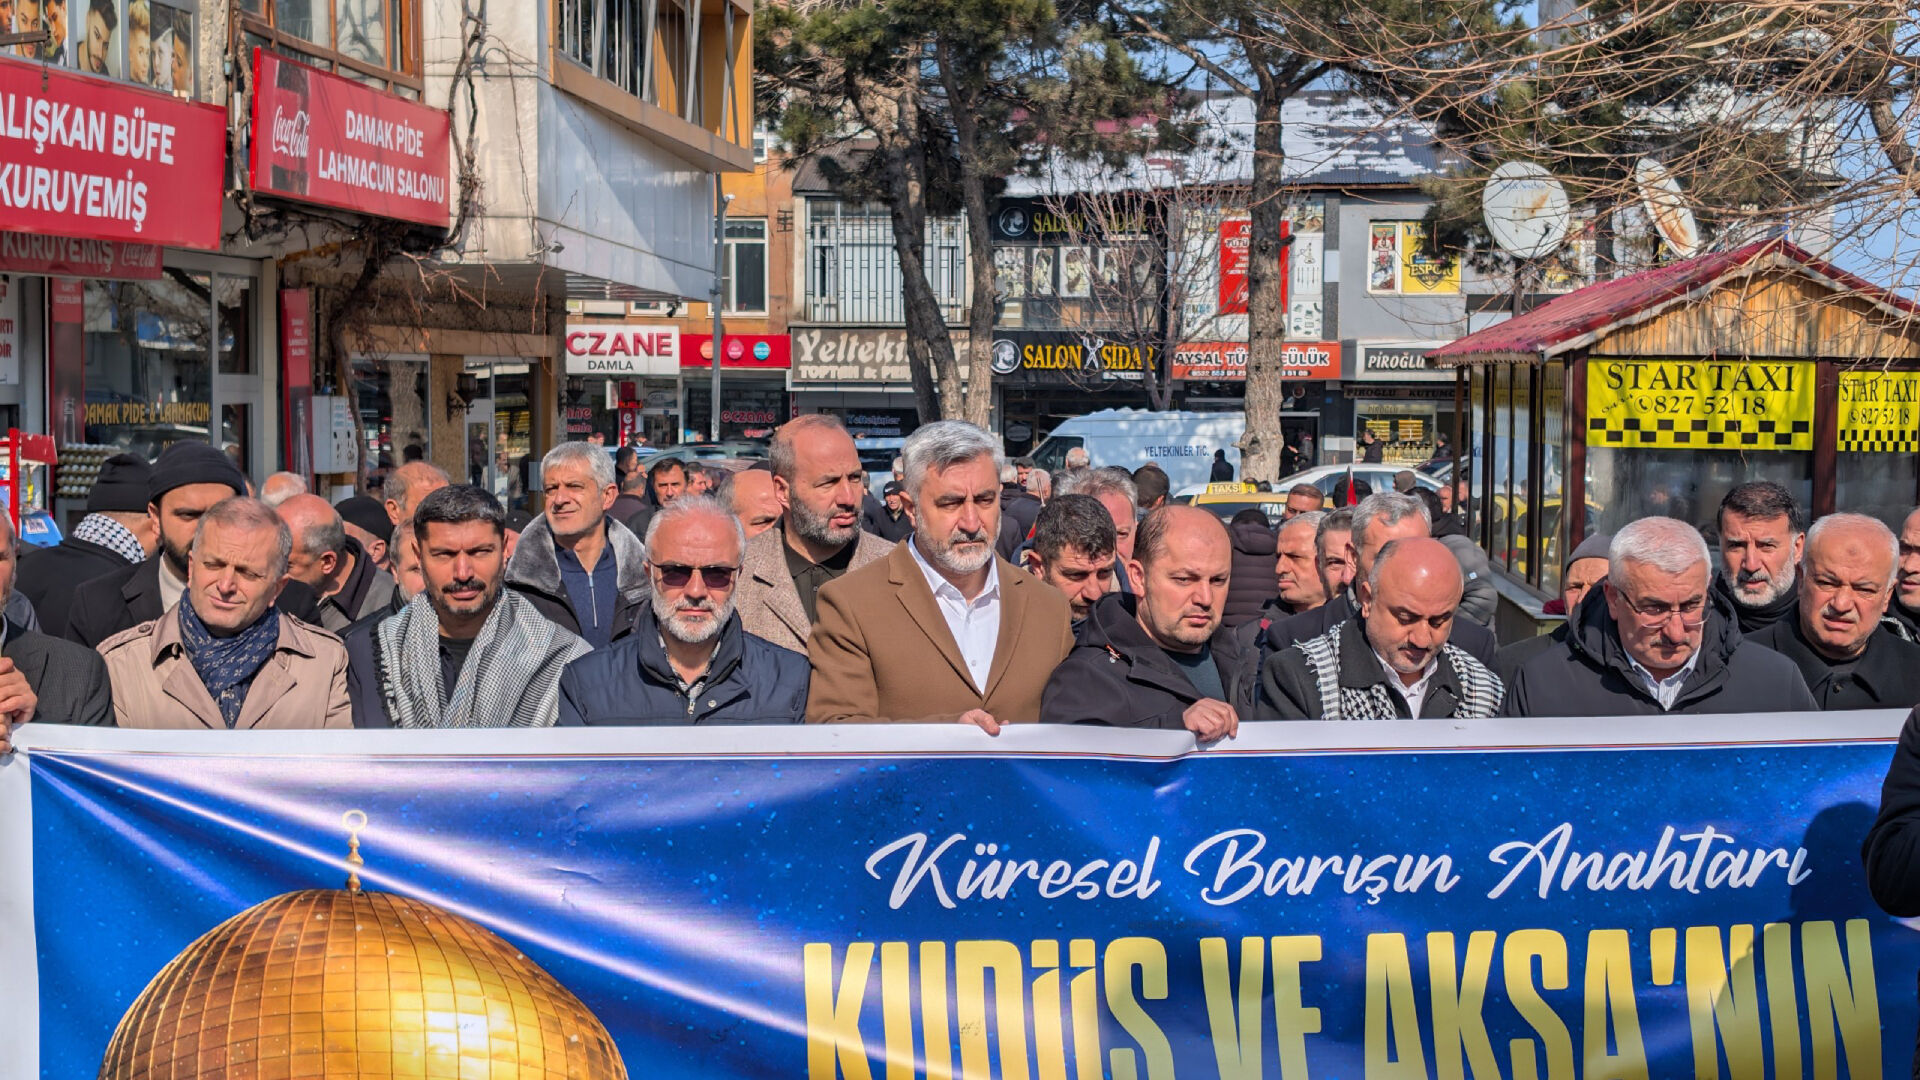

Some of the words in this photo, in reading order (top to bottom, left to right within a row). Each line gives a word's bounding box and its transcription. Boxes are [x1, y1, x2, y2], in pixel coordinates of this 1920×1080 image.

[0, 91, 106, 155] LIŞKAN
[112, 107, 176, 166] BÜFE
[273, 105, 310, 158] Coca-Cola
[346, 110, 394, 151] DAMAK
[396, 119, 424, 158] PİDE
[318, 148, 394, 194] LAHMACUN
[397, 167, 444, 204] SALONU
[0, 162, 148, 232] KURUYEMİŞ
[587, 360, 634, 371] DAMLA
[1023, 344, 1083, 370] SALON
[1175, 351, 1222, 366] AYSAL
[1367, 351, 1426, 369] PİROĞLU
[1607, 363, 1699, 391] STAR
[1708, 364, 1796, 392] TAXI
[1842, 378, 1879, 402] STAR
[1883, 378, 1918, 402] TAXI
[122, 399, 146, 424] PİDE
[160, 402, 210, 424] LAHMACUN
[721, 410, 776, 424] eczane
[1654, 396, 1695, 415] 827
[1704, 396, 1730, 416] 52
[1741, 397, 1767, 416] 18
[1861, 407, 1879, 425] 827
[1882, 407, 1894, 425] 52
[1899, 407, 1910, 425] 18
[1144, 445, 1193, 457] YELTEKİNLER
[865, 832, 1162, 910] Küresel
[1183, 828, 1461, 905] Barışın
[1488, 822, 1813, 900] Anahtarı
[804, 936, 1176, 1080] KUDÜS
[1200, 935, 1323, 1080] VE
[1363, 918, 1885, 1080] AKSA'NIN
